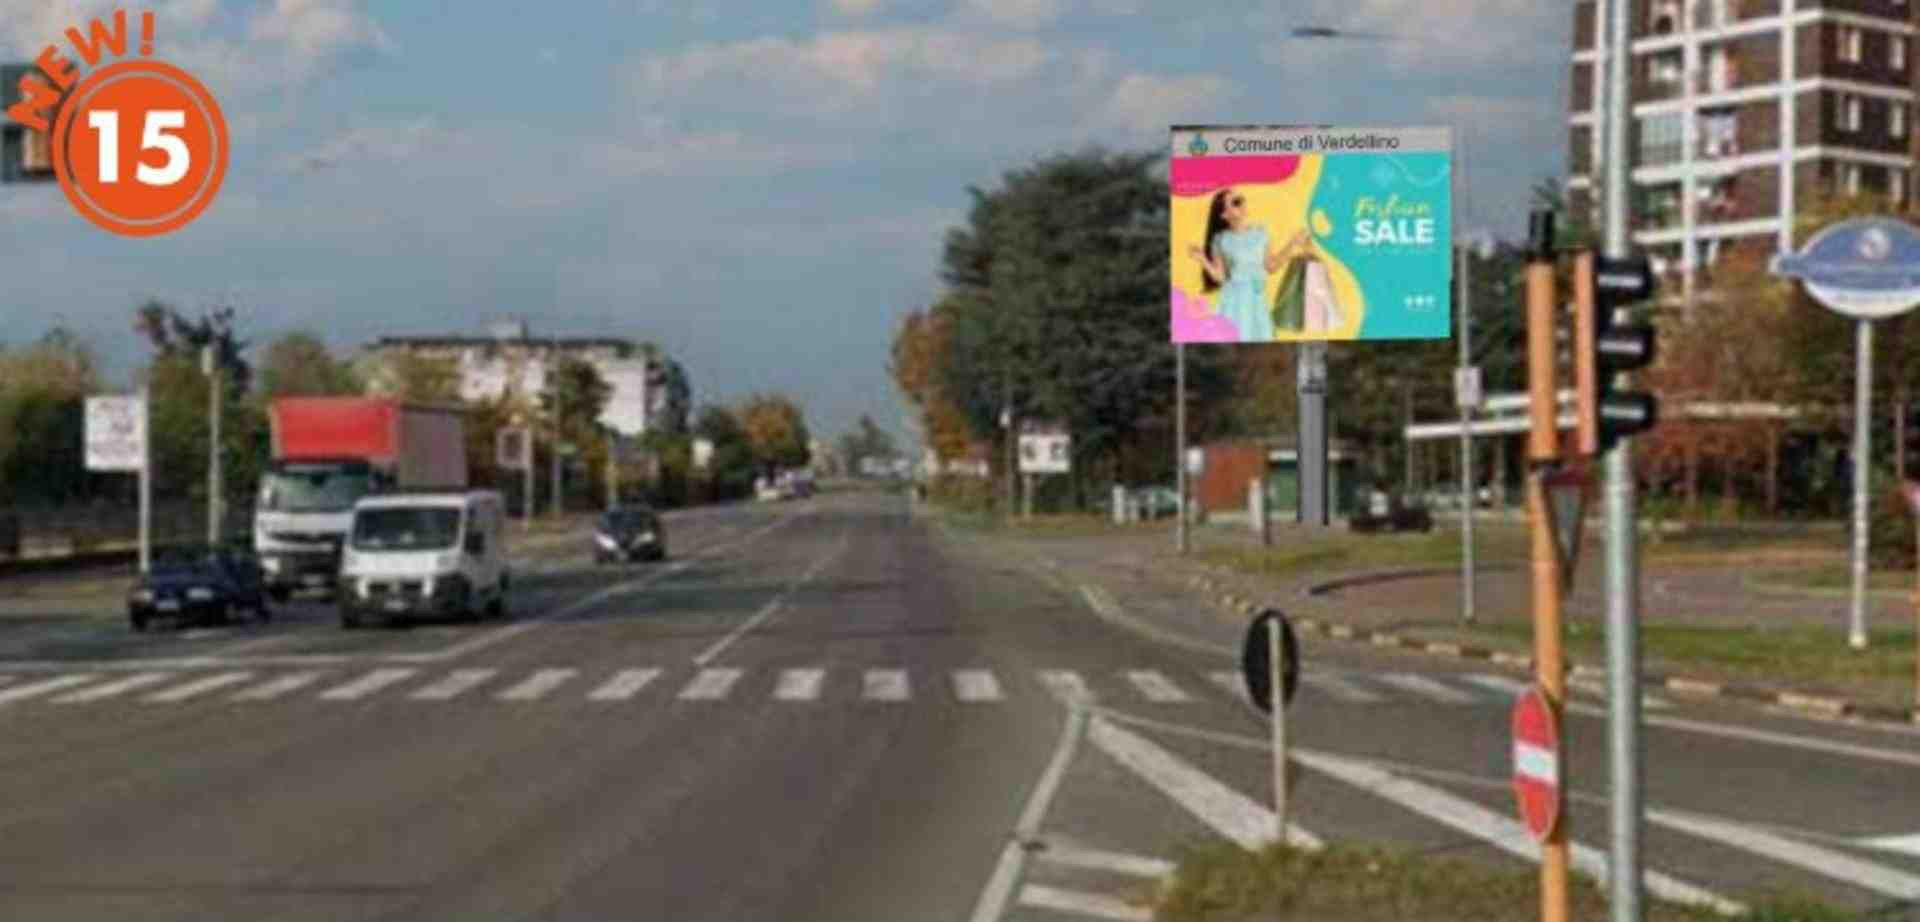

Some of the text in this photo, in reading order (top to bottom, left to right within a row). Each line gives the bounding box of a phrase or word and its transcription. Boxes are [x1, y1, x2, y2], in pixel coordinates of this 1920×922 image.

[1224, 137, 1292, 153] Comune
[1299, 135, 1313, 150] di
[1354, 219, 1435, 244] SALE
